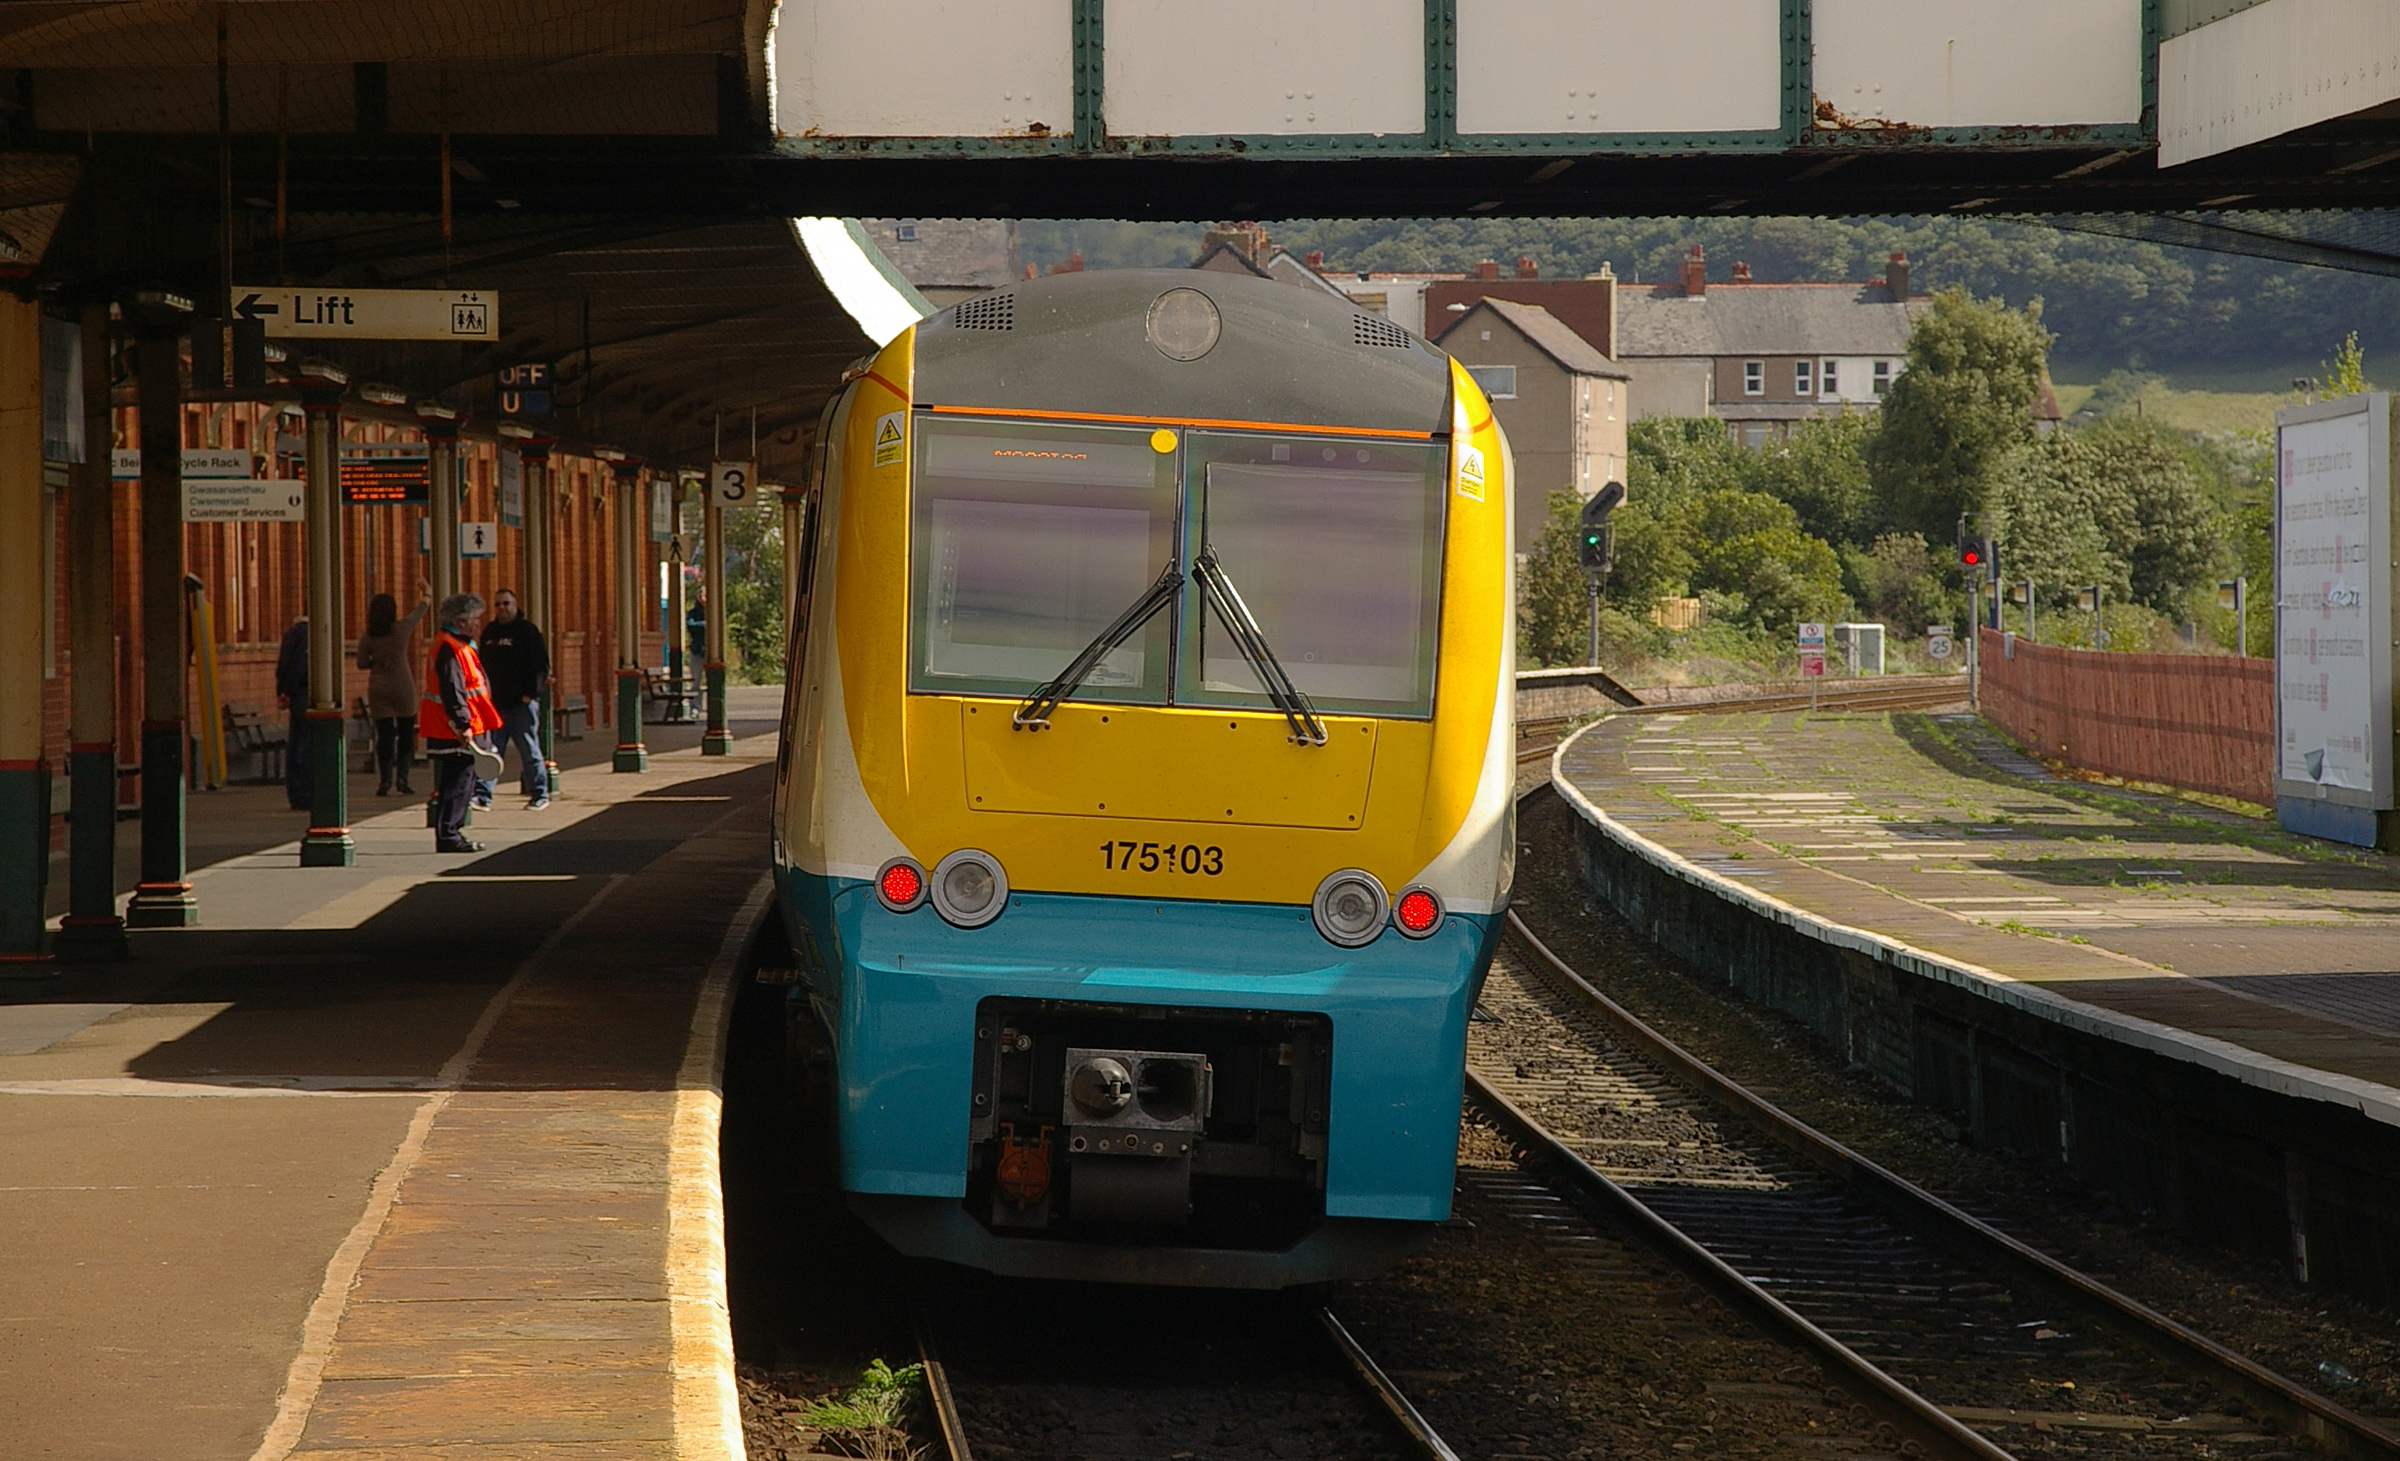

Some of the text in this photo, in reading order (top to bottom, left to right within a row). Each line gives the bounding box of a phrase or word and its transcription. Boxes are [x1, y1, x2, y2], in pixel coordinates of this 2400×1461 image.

[294, 295, 354, 325] Lift
[181, 457, 240, 470] ycle Rack
[722, 469, 746, 501] 3
[189, 508, 287, 518] Customer Services
[1931, 640, 1949, 654] 25
[1100, 840, 1224, 876] 175103
